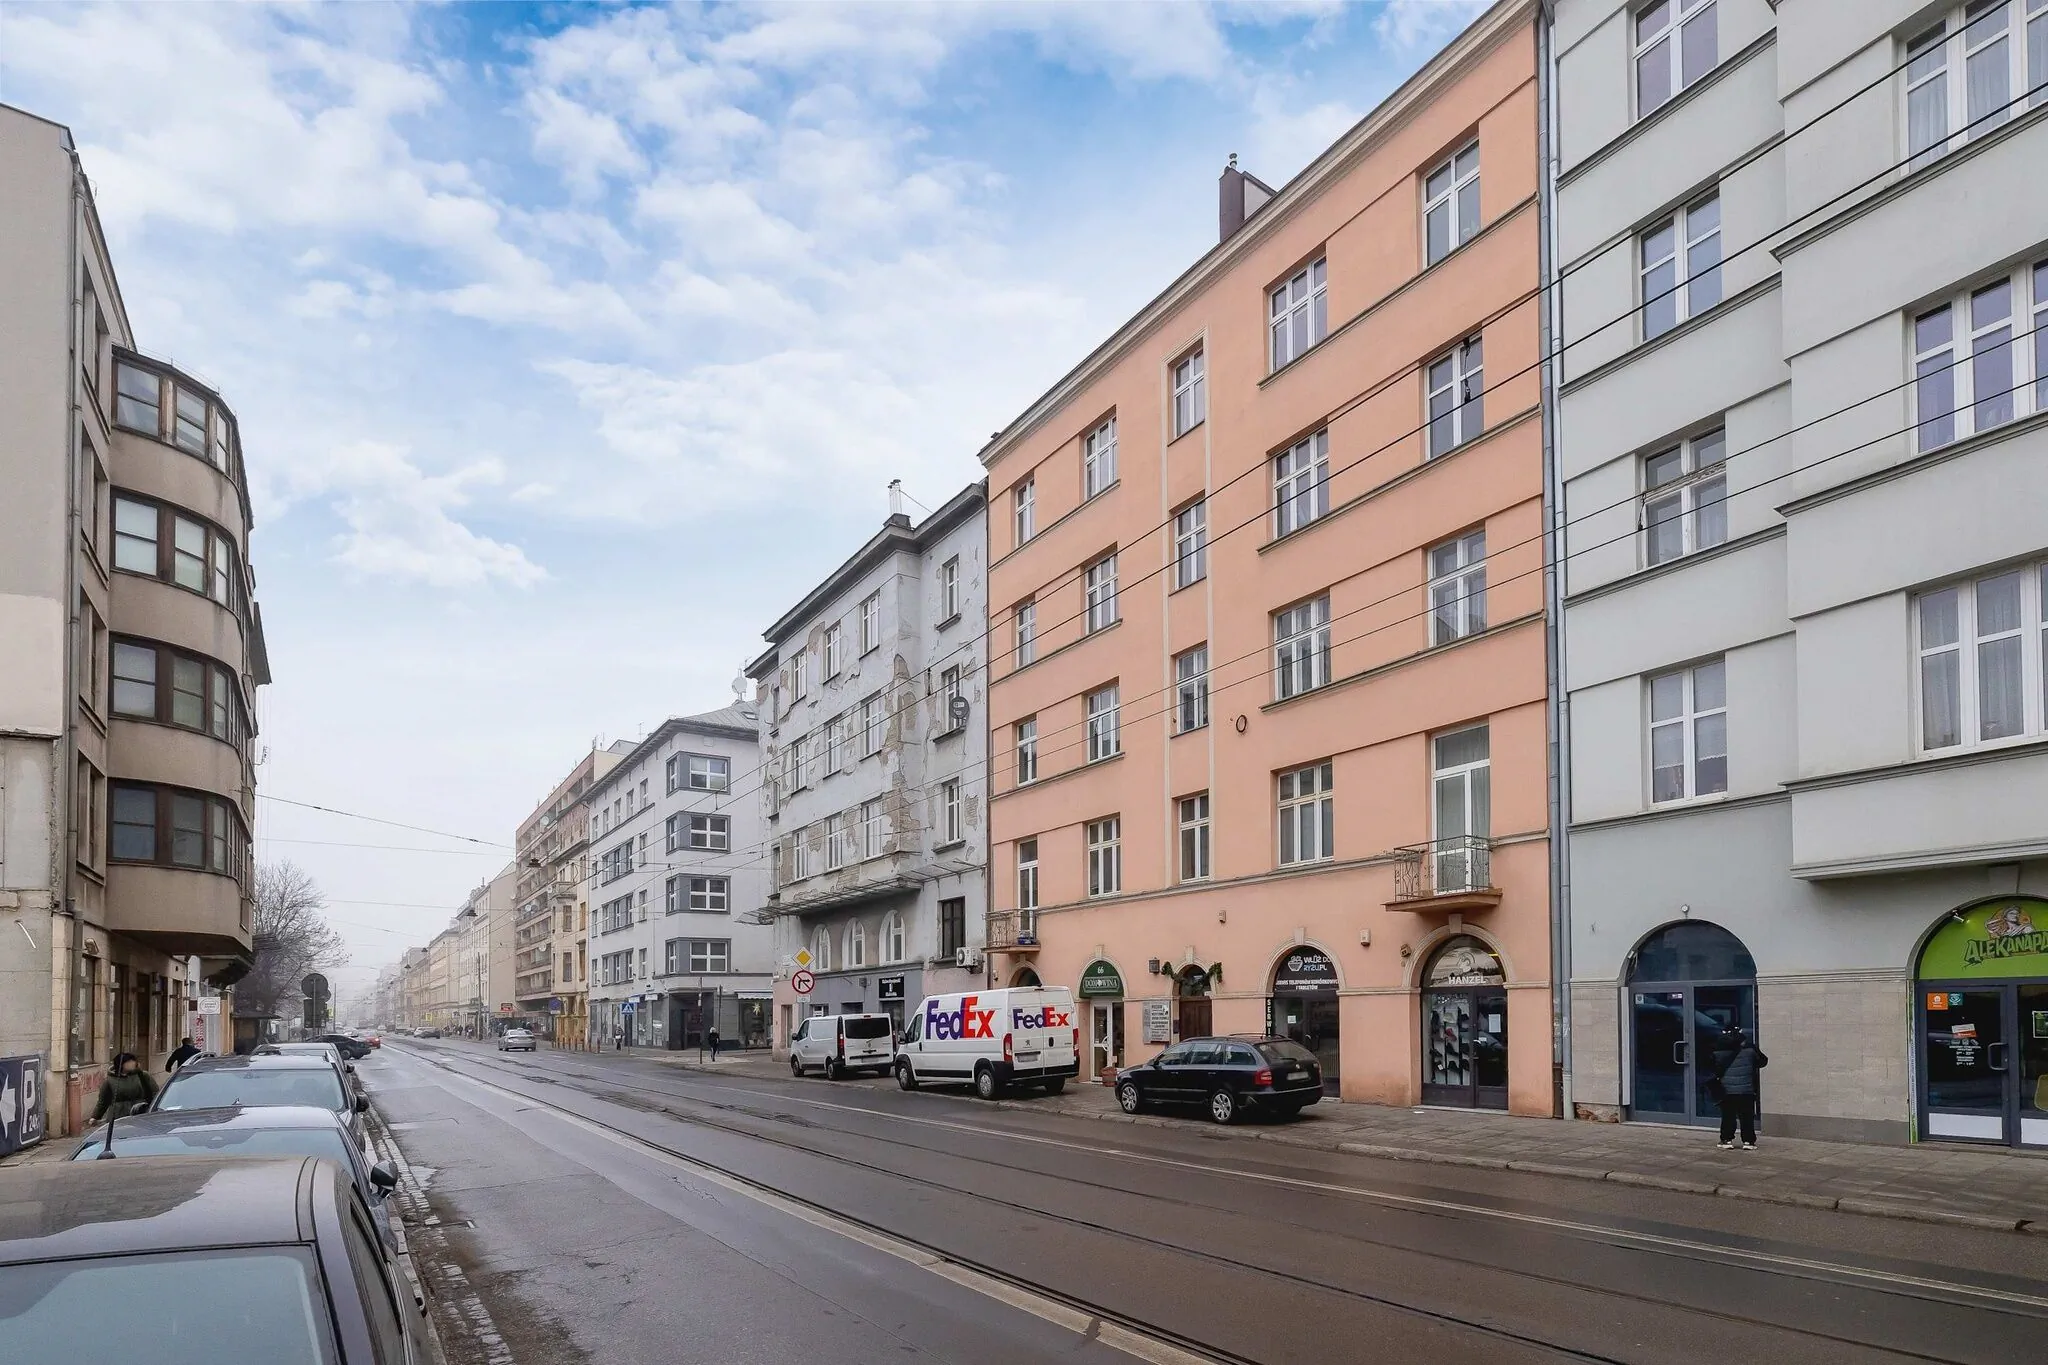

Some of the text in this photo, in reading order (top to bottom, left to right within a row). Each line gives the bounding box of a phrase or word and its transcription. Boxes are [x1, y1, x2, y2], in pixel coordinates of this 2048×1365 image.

[1097, 966, 1105, 974] 66
[1448, 976, 1486, 985] HANZEL
[925, 996, 995, 1040] FedEx
[1012, 1005, 1069, 1029] FedEx
[23, 1070, 36, 1134] P
